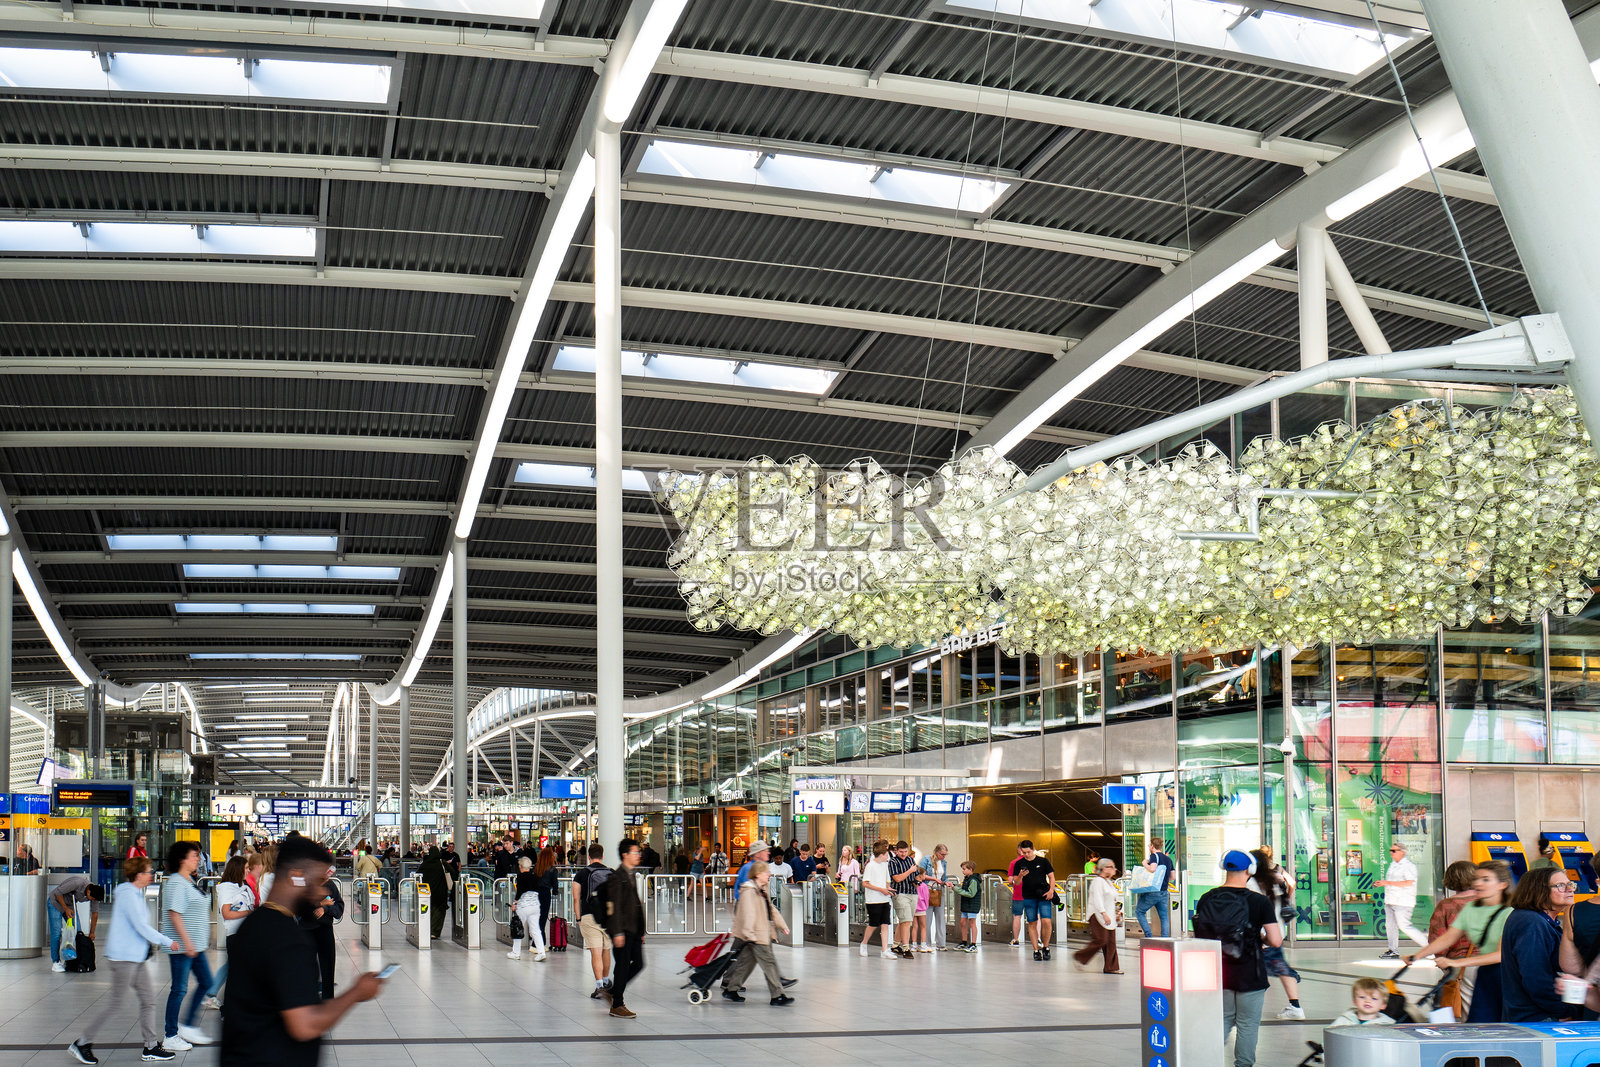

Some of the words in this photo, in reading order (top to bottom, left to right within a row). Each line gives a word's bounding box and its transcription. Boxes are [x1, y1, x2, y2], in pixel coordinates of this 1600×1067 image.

[942, 634, 973, 656] BAR
[683, 796, 709, 805] STARBUCKS
[799, 799, 824, 813] 1-4
[215, 803, 236, 814] 1-4
